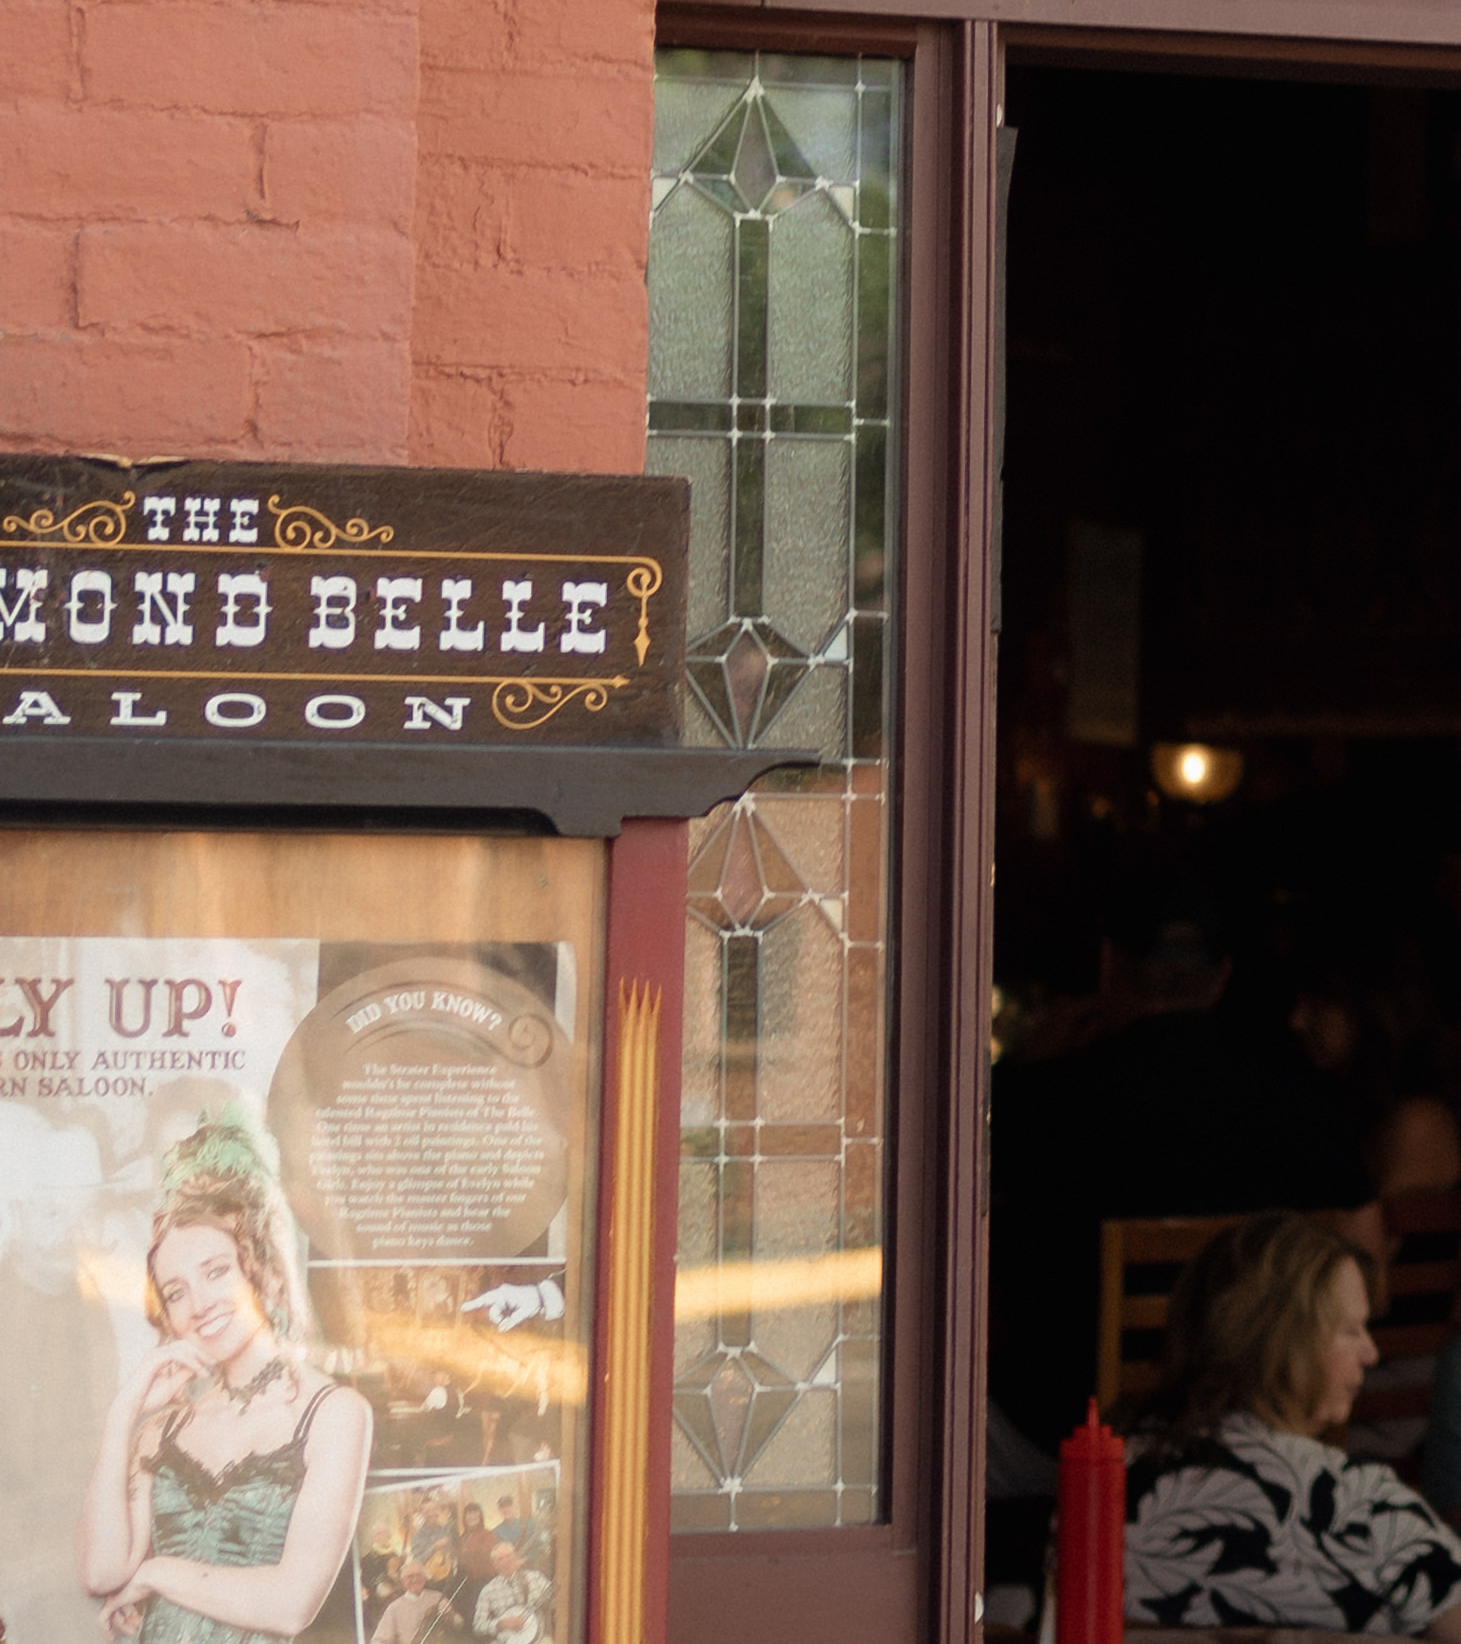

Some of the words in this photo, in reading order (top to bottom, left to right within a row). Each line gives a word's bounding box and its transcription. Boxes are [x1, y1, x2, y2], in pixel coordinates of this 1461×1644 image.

[143, 495, 260, 544] THE
[308, 575, 609, 655] BELLE
[104, 978, 243, 1039] UP!
[345, 1001, 383, 1035] DID
[383, 990, 427, 1015] YOU
[430, 991, 503, 1032] KNOW?
[13, 1050, 82, 1072] ONLY
[90, 1049, 247, 1072] AUTHENTIC
[37, 1076, 154, 1098] SALOON.
